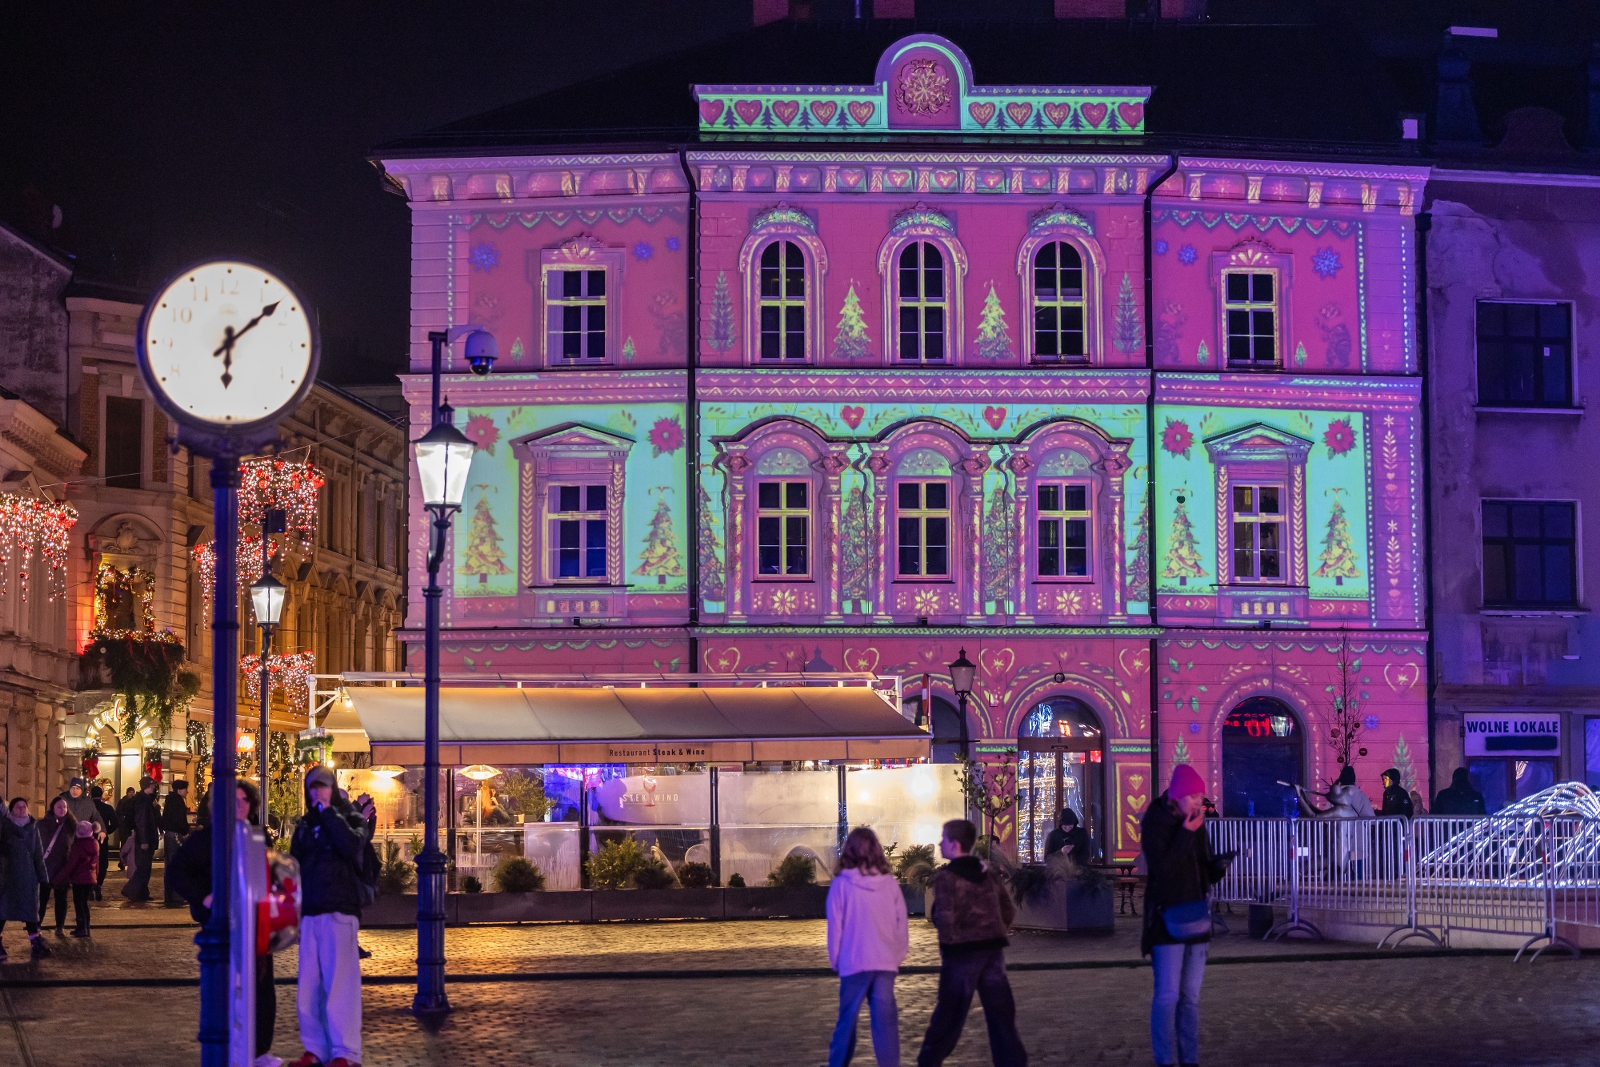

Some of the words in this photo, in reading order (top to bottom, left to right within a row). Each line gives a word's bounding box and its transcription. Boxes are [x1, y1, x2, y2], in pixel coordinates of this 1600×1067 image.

[192, 285, 210, 303] 11
[219, 278, 240, 296] 12
[172, 306, 194, 324] 10
[85, 711, 113, 746] STEK
[1466, 721, 1509, 733] WOLNE
[1514, 721, 1559, 733] LOKALE
[609, 748, 651, 757] Restaurant
[652, 748, 676, 756] Steak
[678, 748, 684, 756] &
[686, 748, 705, 756] Wine
[622, 793, 647, 802] STEK
[654, 793, 679, 802] WINO
